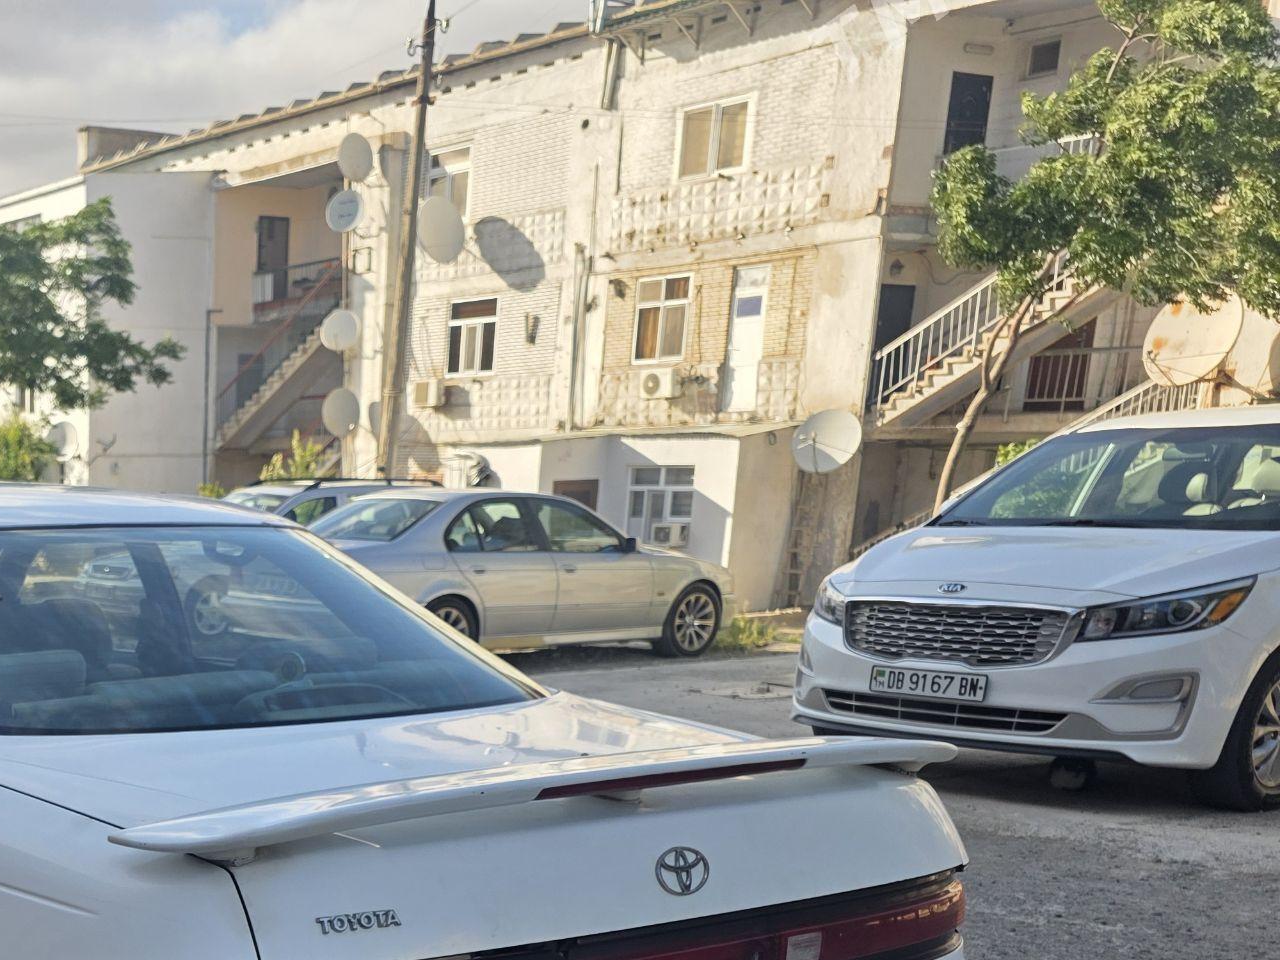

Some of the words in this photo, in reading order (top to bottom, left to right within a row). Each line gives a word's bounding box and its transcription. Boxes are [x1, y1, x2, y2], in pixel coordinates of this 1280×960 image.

[887, 671, 905, 689] DB
[908, 673, 955, 694] 9167
[958, 677, 979, 697] BN
[315, 909, 402, 934] TOYOTA
